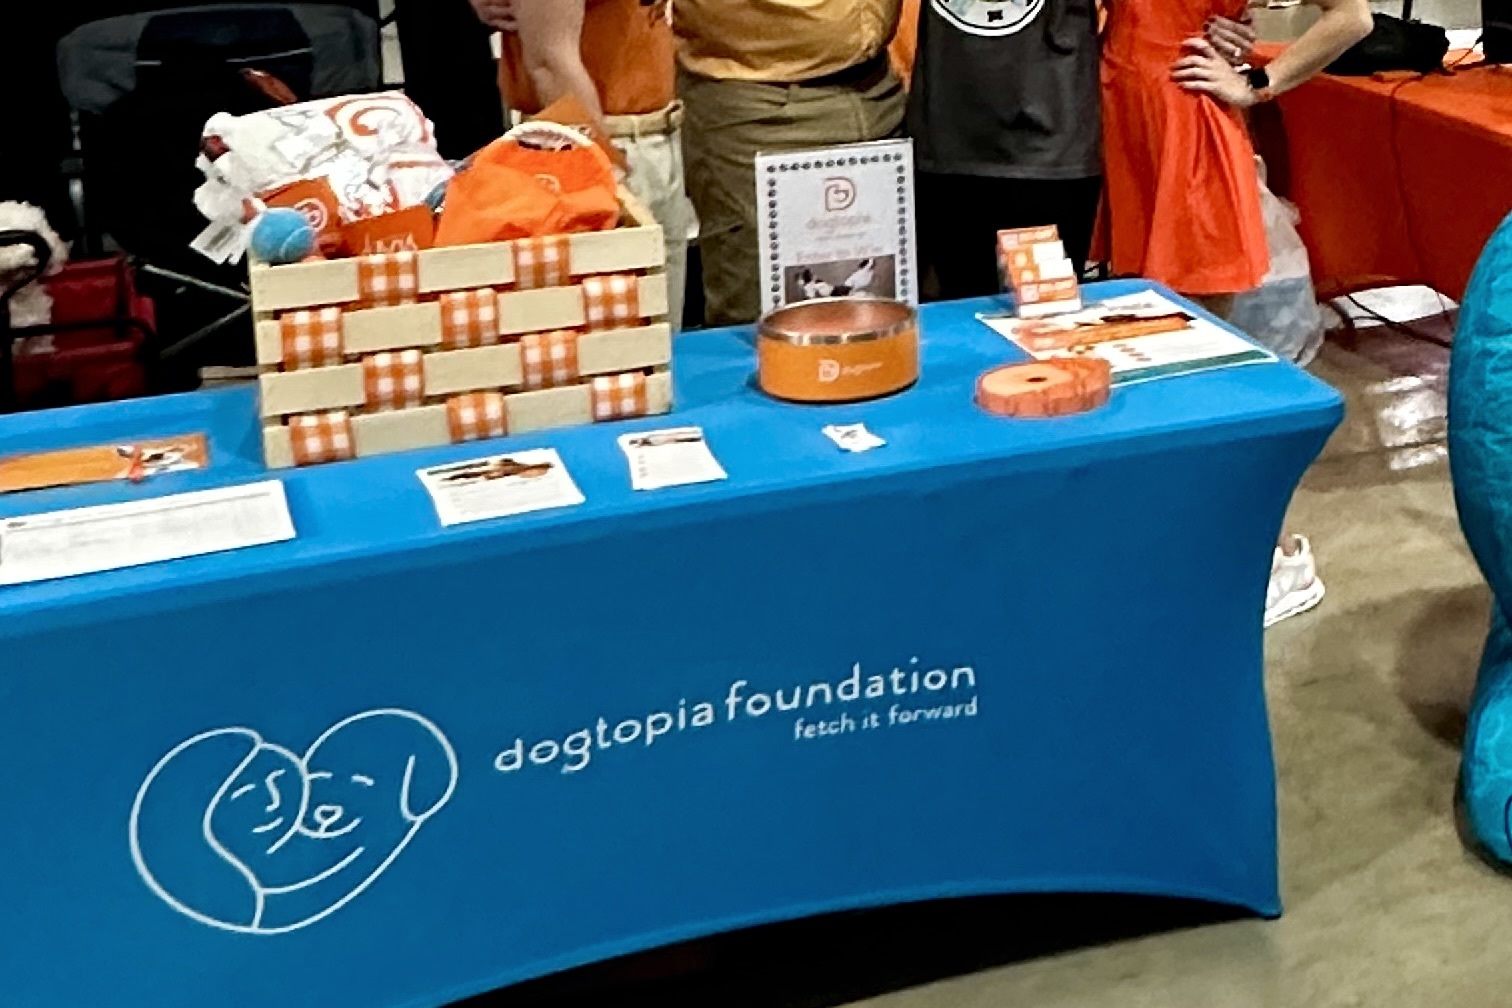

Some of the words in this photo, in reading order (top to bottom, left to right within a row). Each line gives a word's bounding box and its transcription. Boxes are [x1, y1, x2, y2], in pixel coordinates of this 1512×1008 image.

[494, 699, 716, 775] dogtopia
[725, 657, 978, 722] foundation
[795, 714, 855, 741] fetch
[862, 708, 881, 730] it
[889, 697, 978, 727] forward
